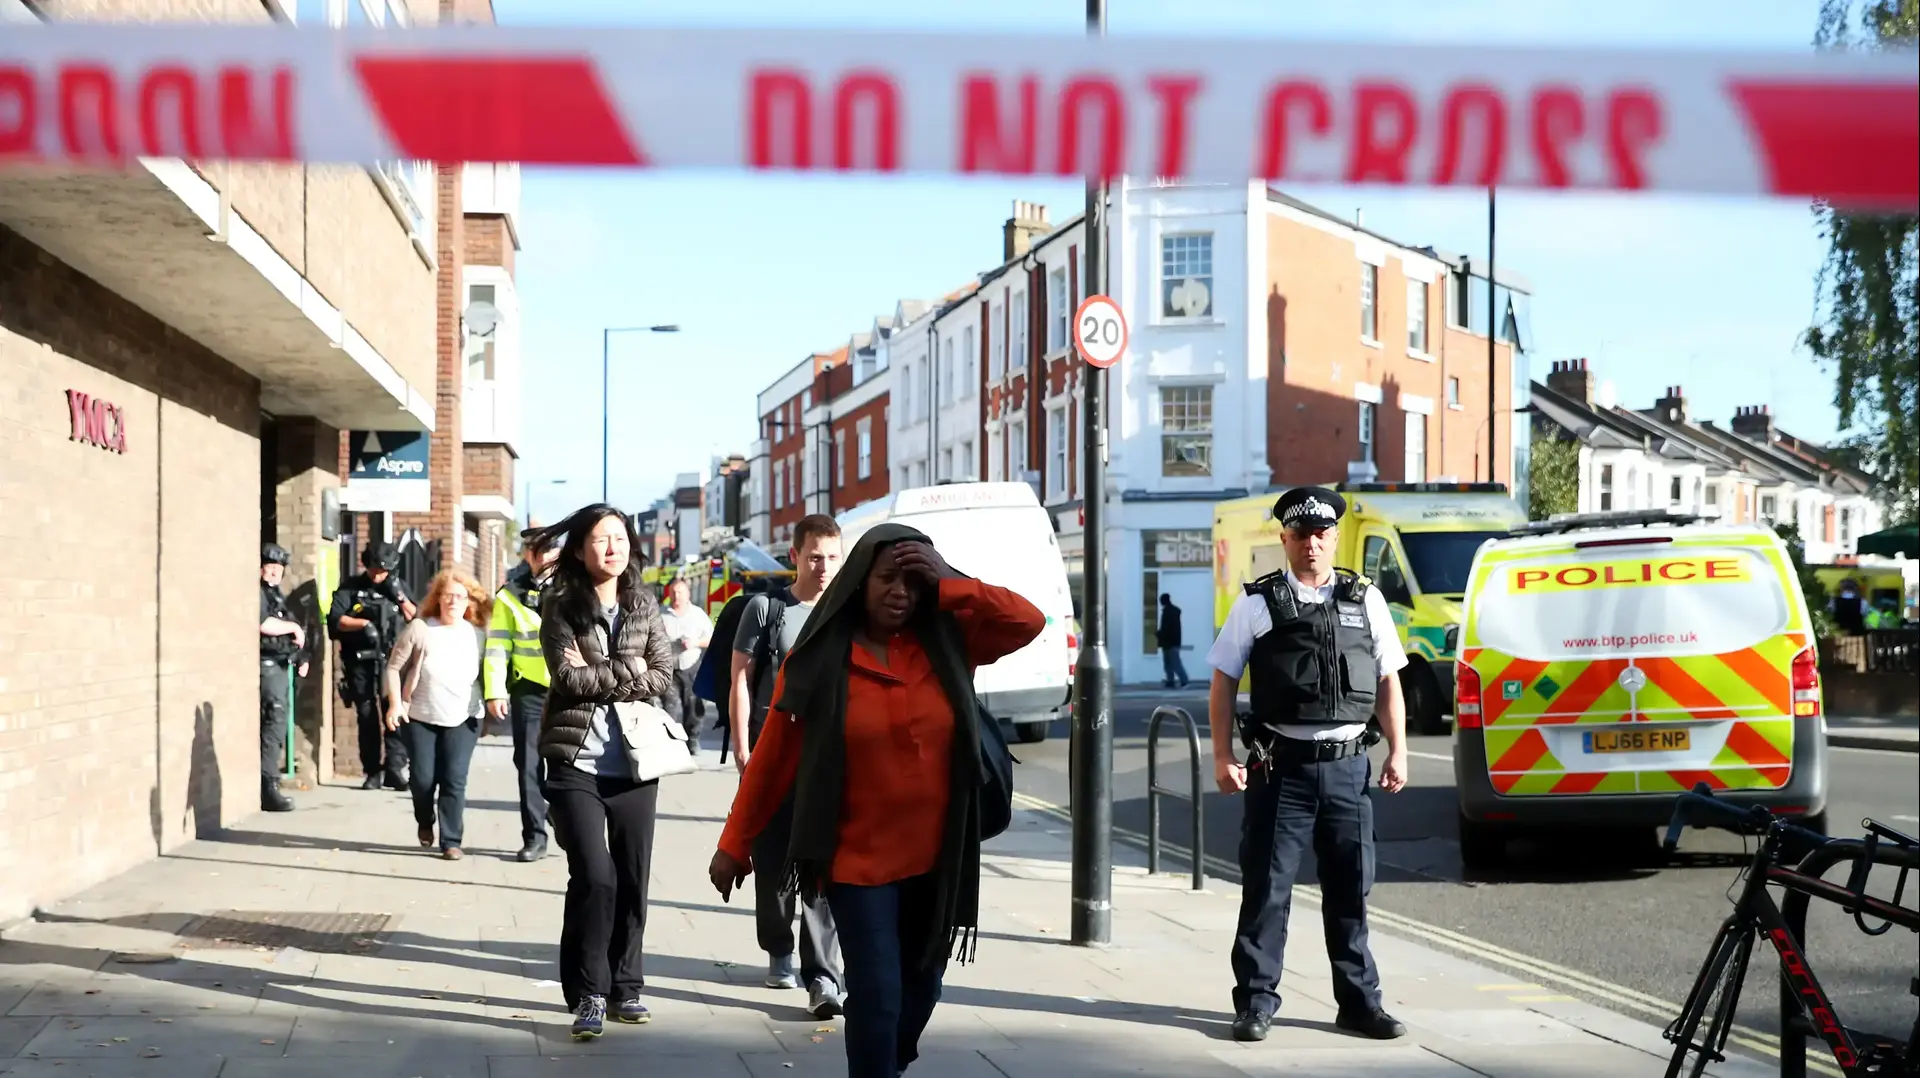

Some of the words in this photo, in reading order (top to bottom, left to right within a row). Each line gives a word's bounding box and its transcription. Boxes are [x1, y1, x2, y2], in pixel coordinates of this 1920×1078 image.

[747, 69, 898, 170] DO
[960, 71, 1204, 178] NOT
[1260, 79, 1664, 190] CROSS
[1084, 316, 1119, 346] 20
[65, 388, 128, 454] YMCA
[377, 456, 424, 476] Aspire
[1517, 560, 1741, 589] POLICE
[1563, 631, 1697, 649] www.btp.police.uk
[1595, 733, 1644, 750] LJ66
[1649, 731, 1686, 749] FNP
